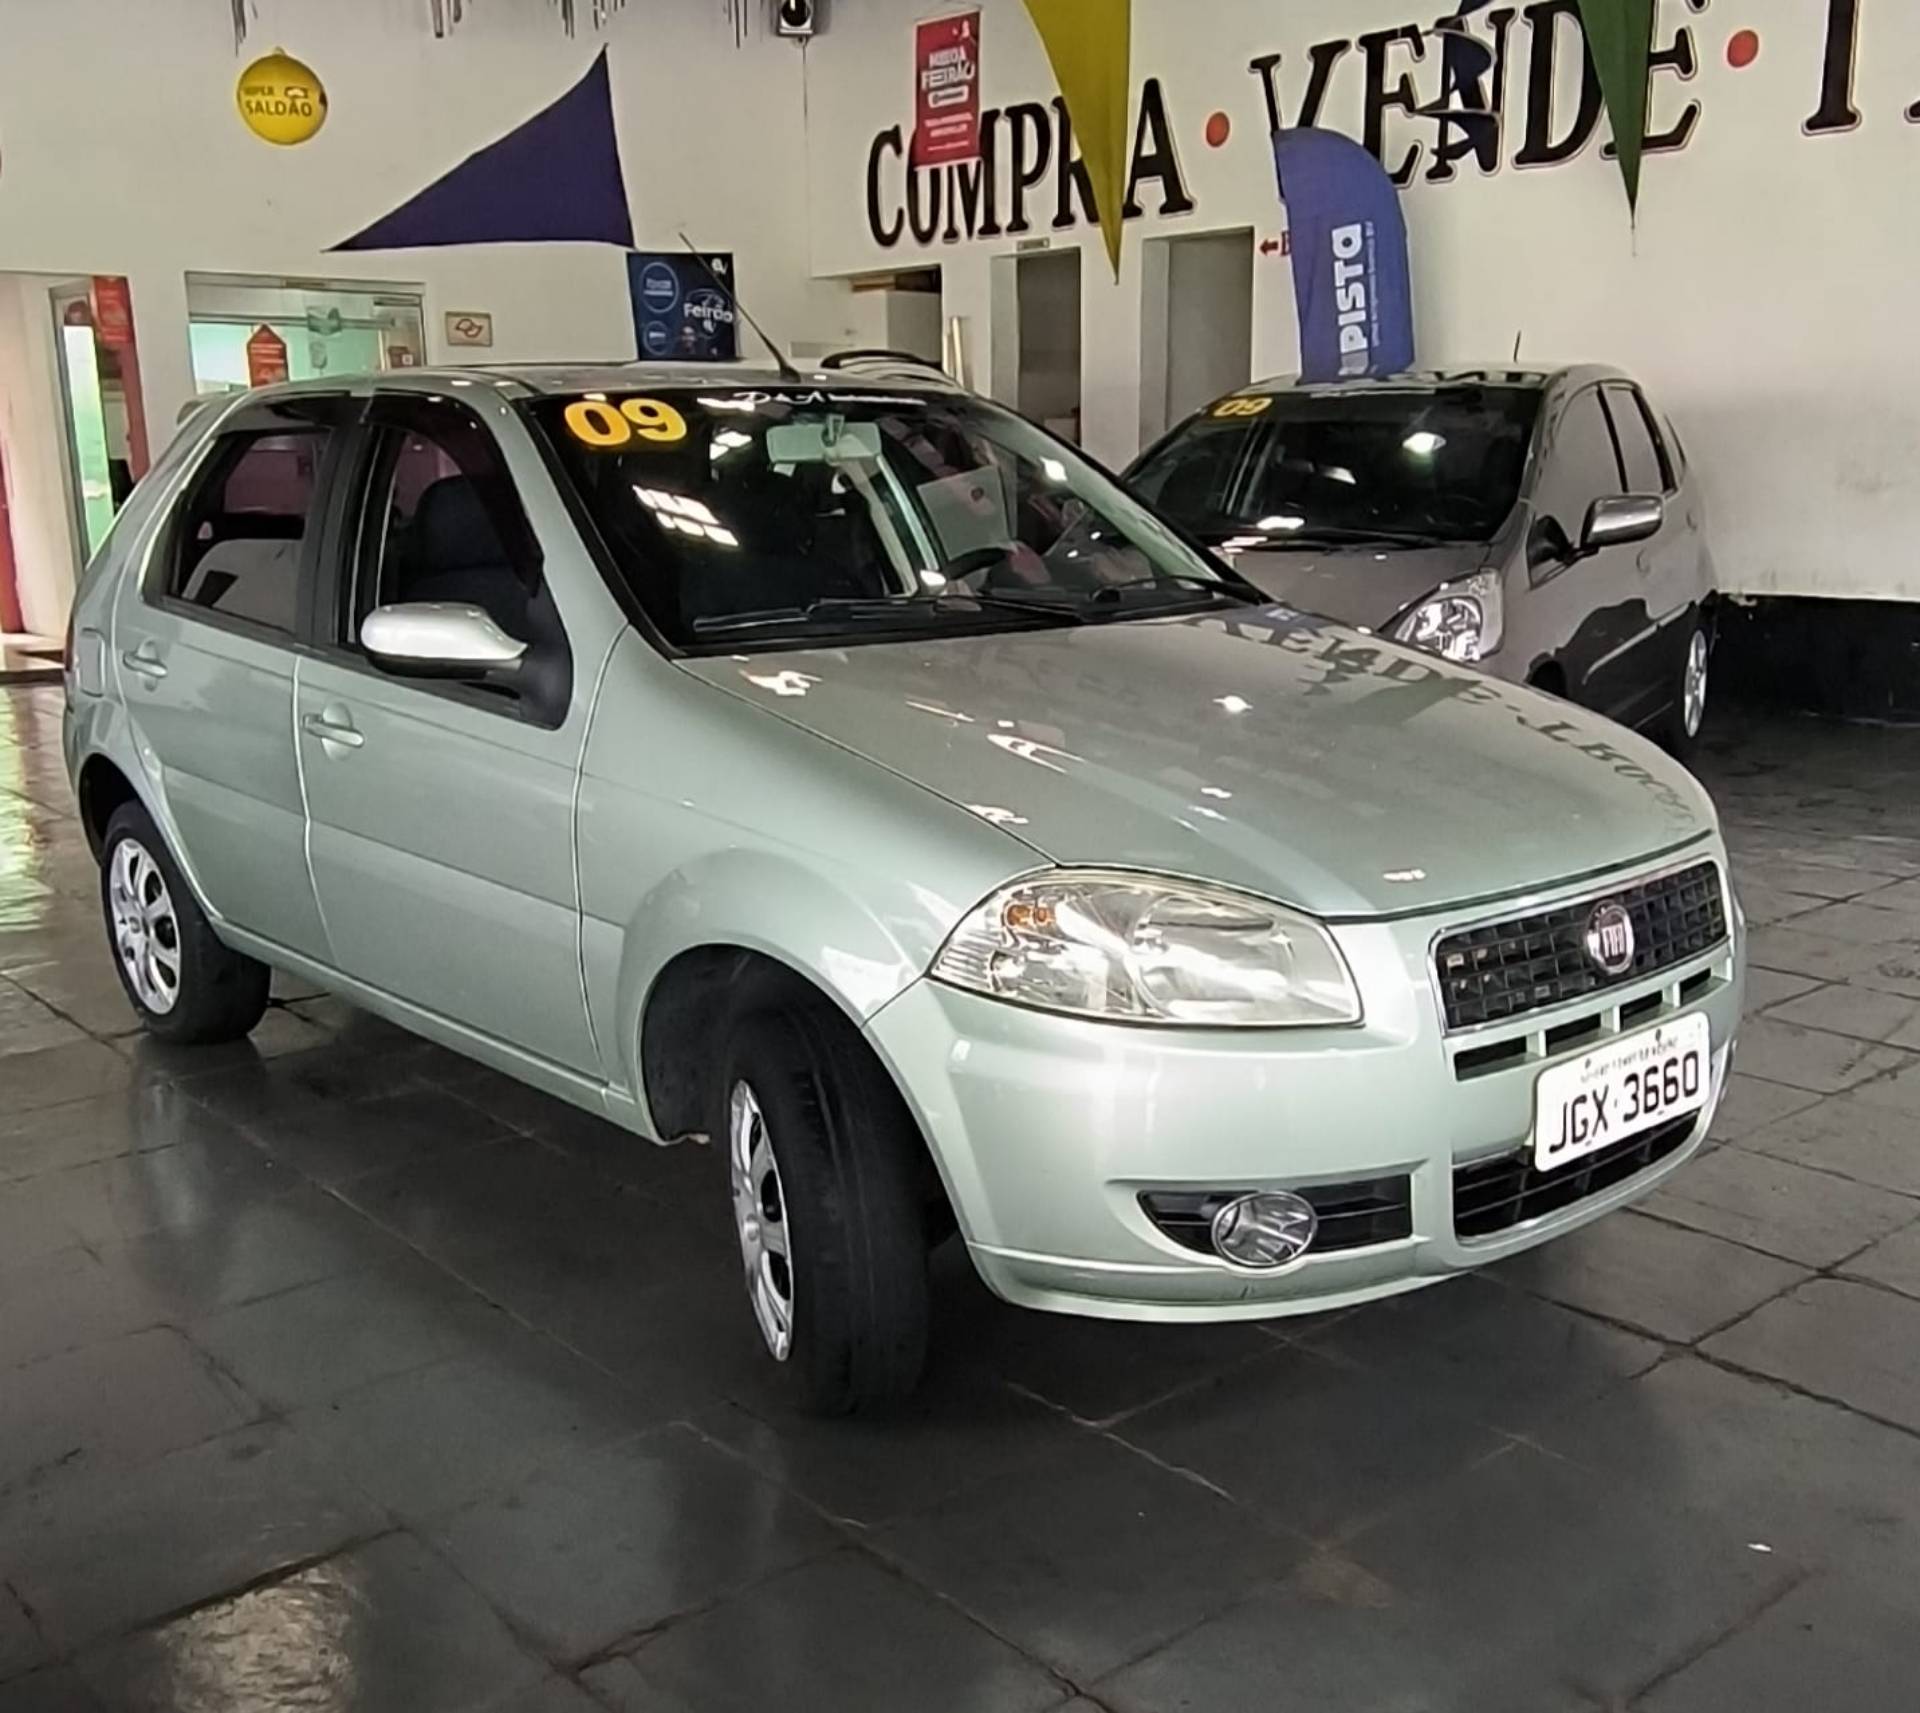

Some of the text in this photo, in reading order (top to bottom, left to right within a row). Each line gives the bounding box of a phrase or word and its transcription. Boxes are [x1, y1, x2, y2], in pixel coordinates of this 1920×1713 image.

[866, 77, 1197, 247] COMPRA
[683, 301, 734, 324] Feirão
[564, 398, 688, 446] 09
[1212, 397, 1273, 417] 09
